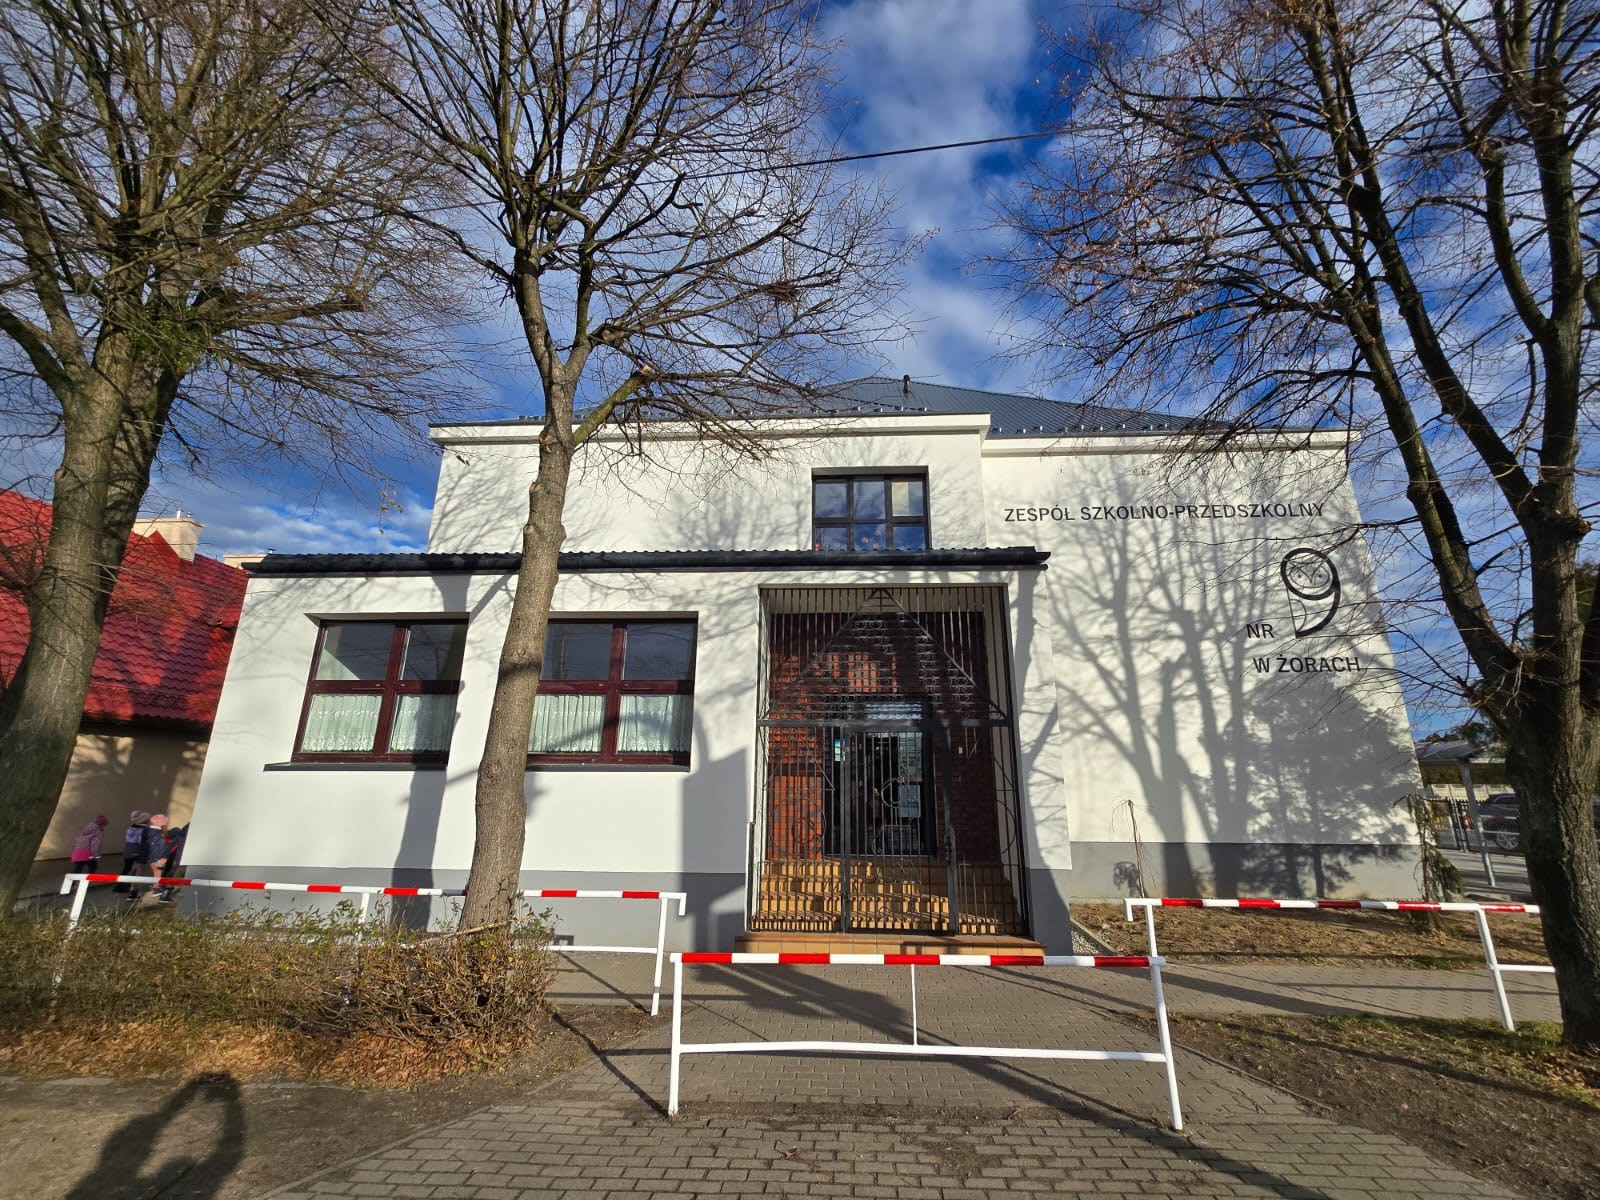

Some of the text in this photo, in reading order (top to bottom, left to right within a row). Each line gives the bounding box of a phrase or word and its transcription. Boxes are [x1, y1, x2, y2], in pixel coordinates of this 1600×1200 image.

[1004, 502, 1324, 522] ZESPÓŁ SZKOLNO-PRZEDSZKOLNY
[1246, 623, 1275, 639] NR
[1253, 653, 1361, 673] W ŻORACH
